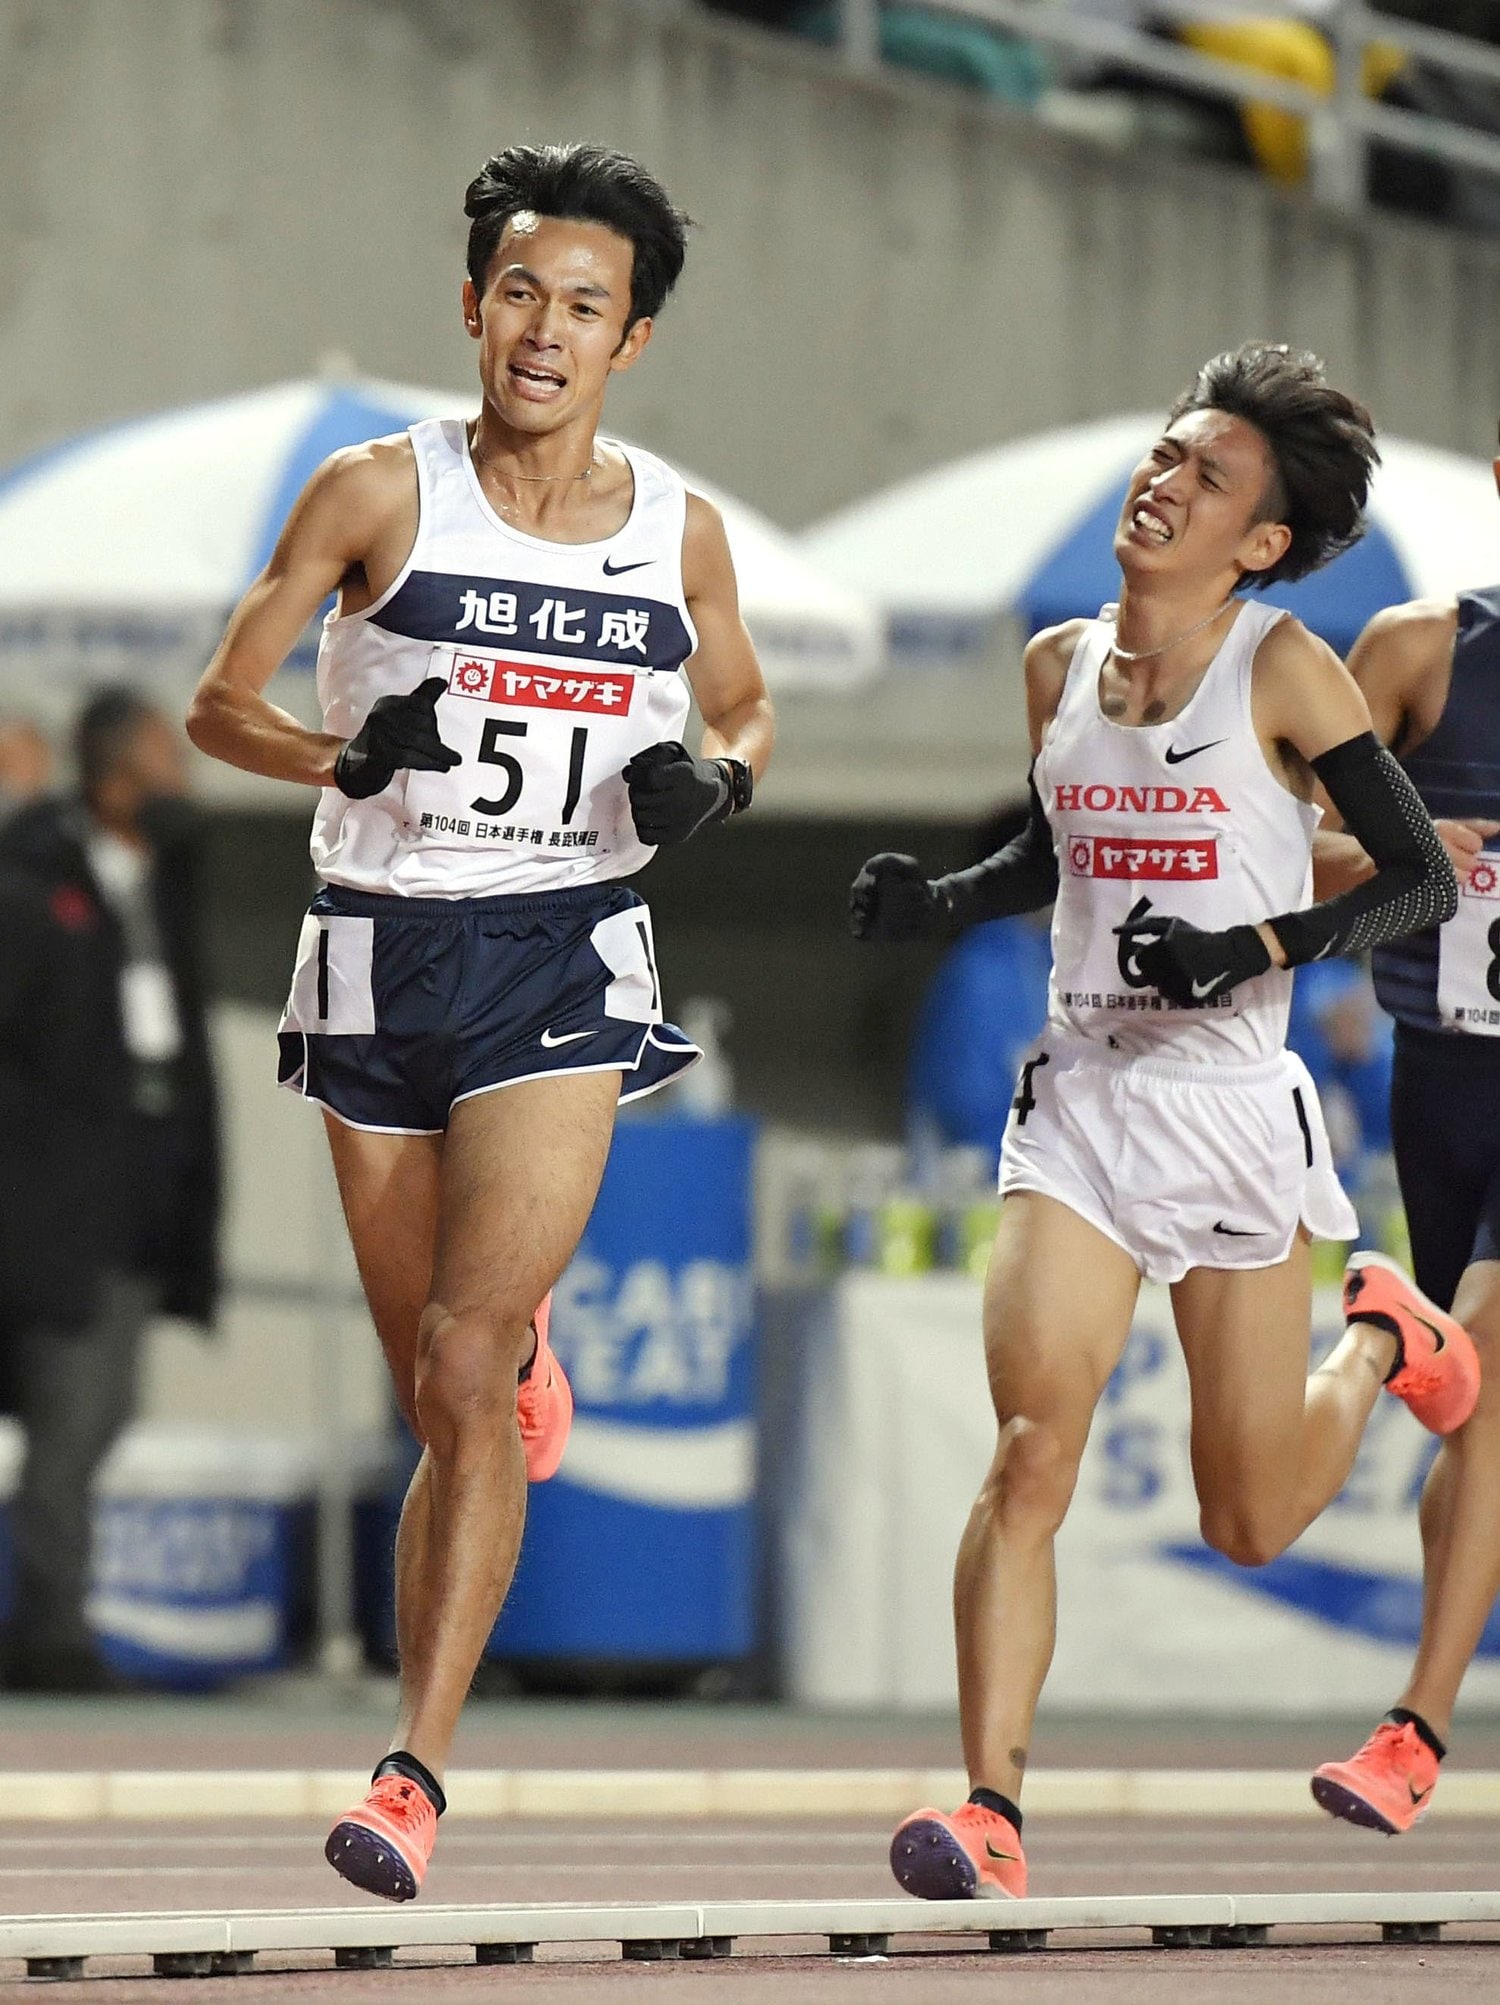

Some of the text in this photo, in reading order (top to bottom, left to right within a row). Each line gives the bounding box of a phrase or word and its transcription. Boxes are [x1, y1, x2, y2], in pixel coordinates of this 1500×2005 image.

[455, 589, 650, 655] 旭化成
[502, 671, 624, 706] ヤマザキ
[470, 718, 588, 825] 51
[1055, 784, 1231, 813] HONDA
[419, 812, 470, 836] 第104回
[475, 822, 544, 844] 日本選手権
